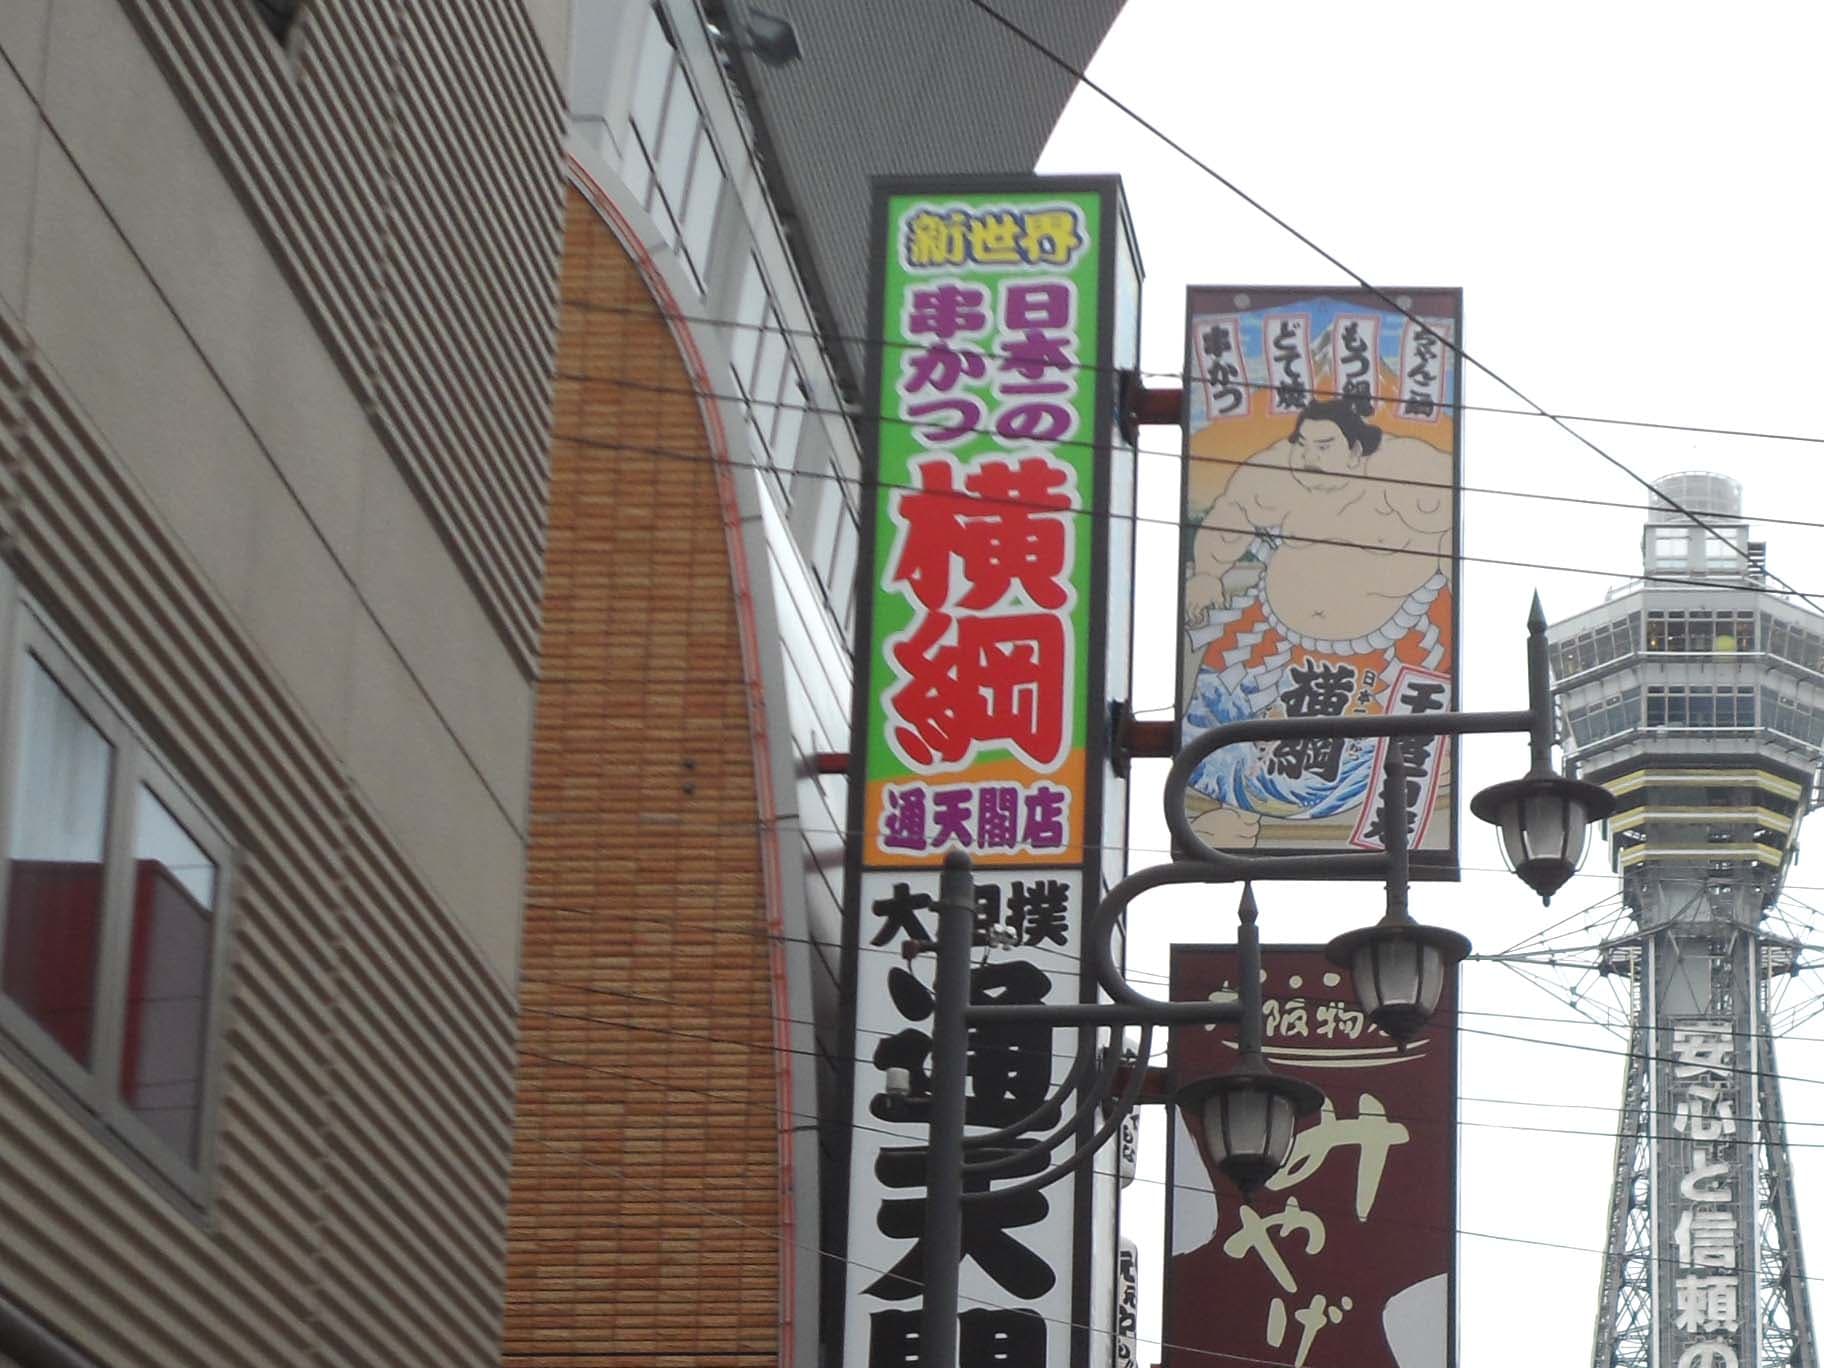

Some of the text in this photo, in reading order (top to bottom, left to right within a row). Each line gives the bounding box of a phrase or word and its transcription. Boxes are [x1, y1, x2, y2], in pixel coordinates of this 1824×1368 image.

[909, 208, 1082, 267] 新世界
[905, 286, 987, 443] 串かつ
[998, 283, 1072, 442] 日本一の
[1203, 325, 1242, 413] 串かつ
[890, 461, 1072, 766] 横綱
[881, 786, 1065, 850] 通天閣店
